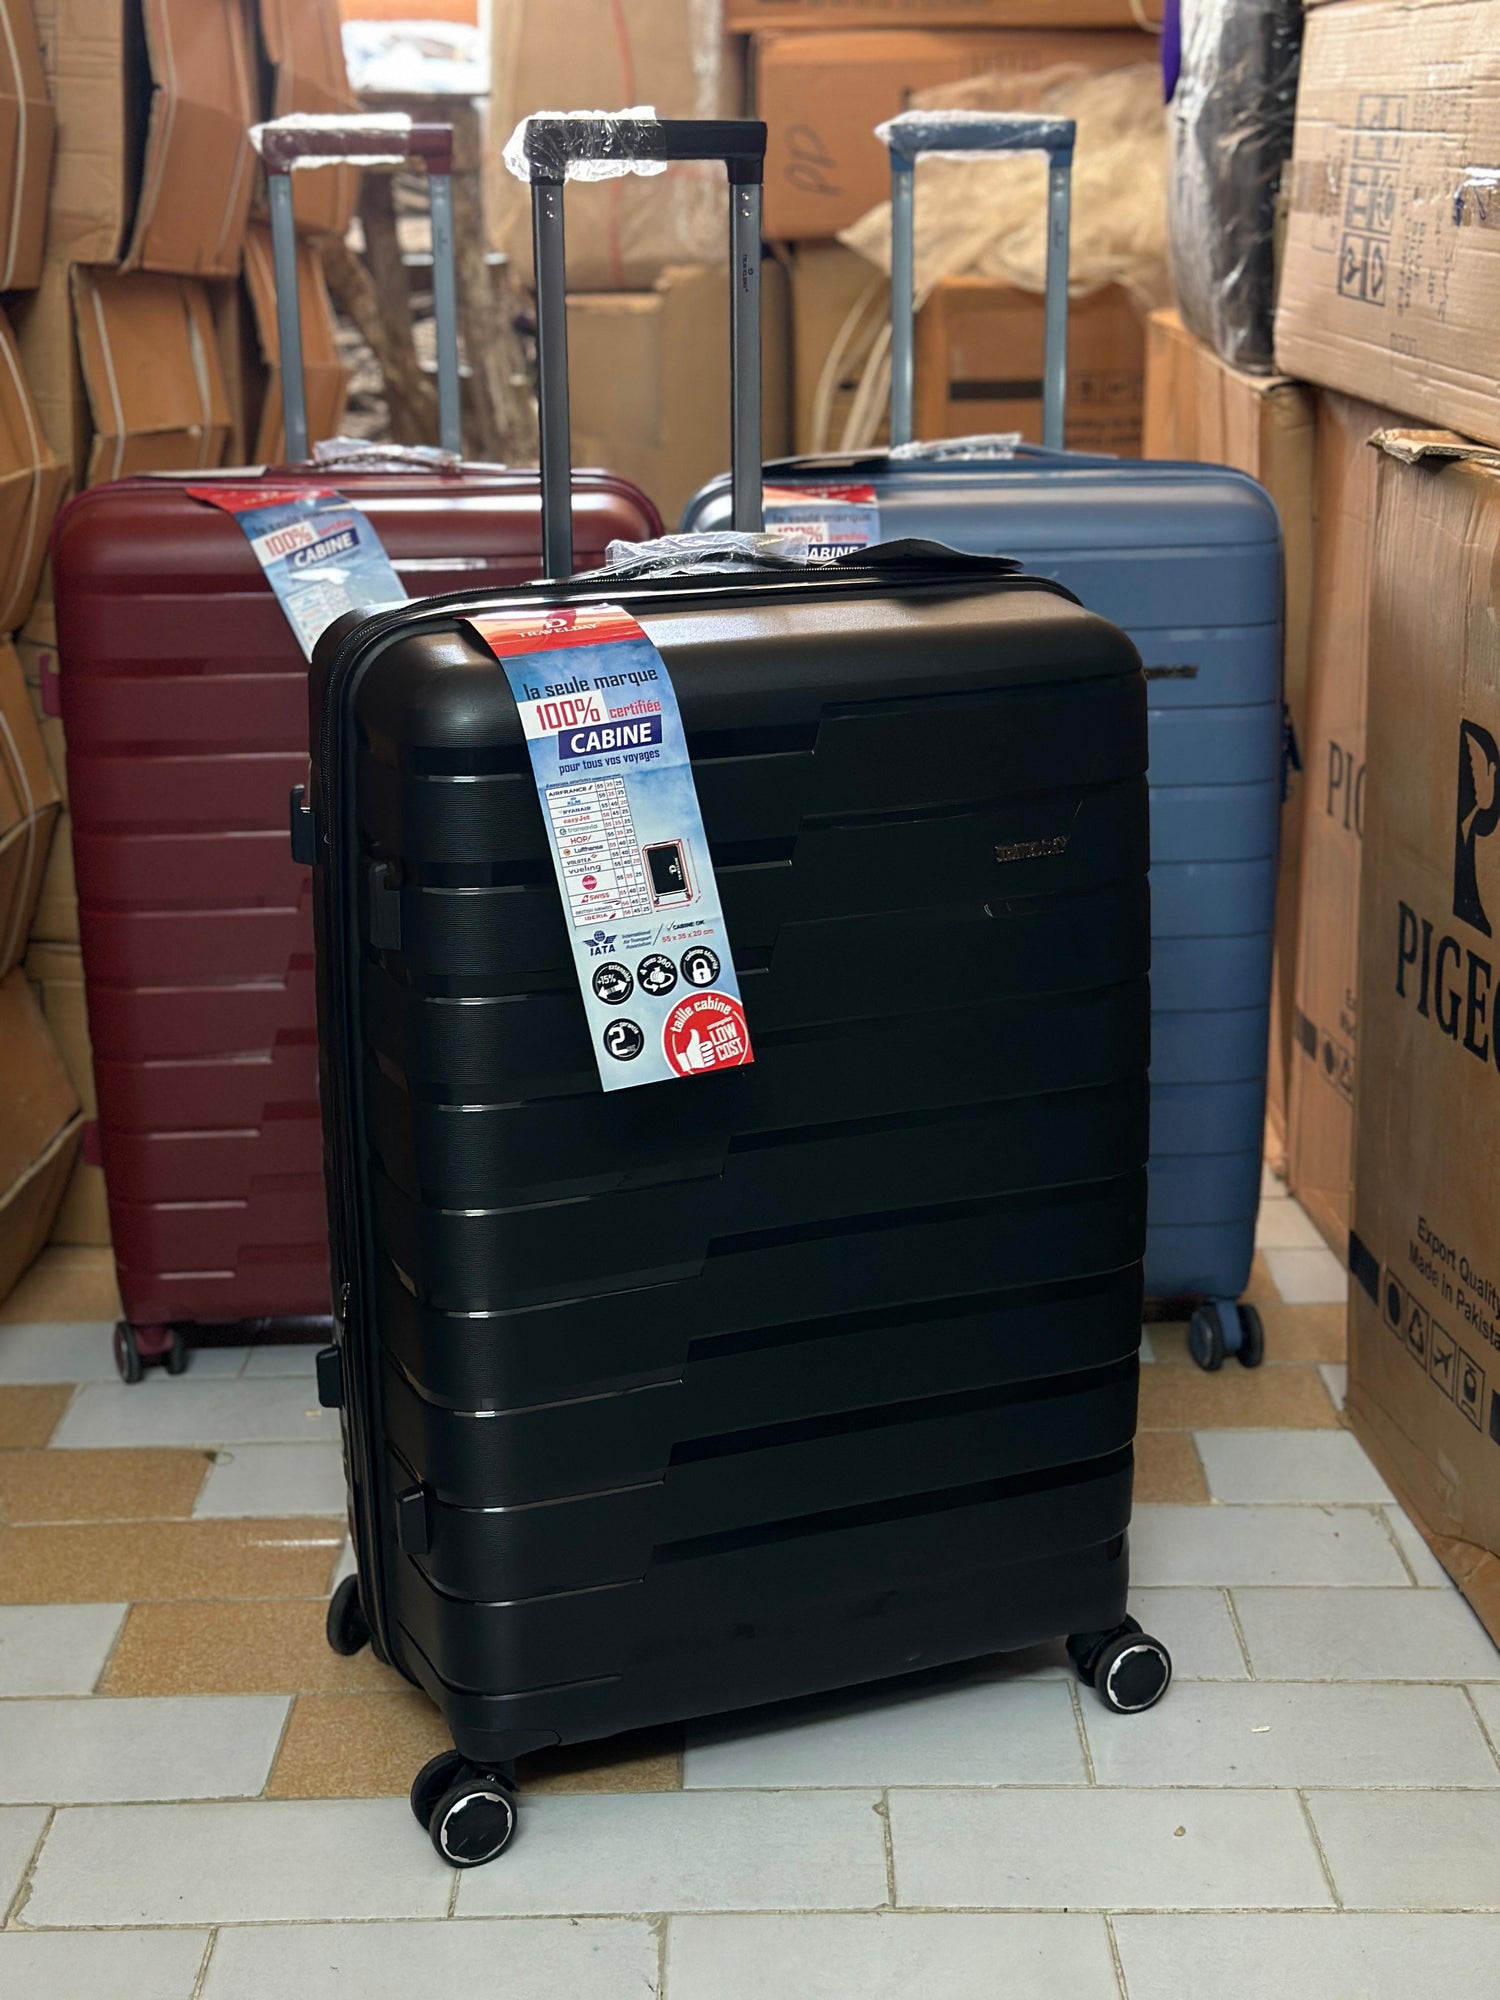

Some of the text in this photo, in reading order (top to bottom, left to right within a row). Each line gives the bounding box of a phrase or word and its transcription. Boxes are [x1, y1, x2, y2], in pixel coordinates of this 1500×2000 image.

[264, 526, 314, 558] 100%
[294, 531, 354, 568] CABINE
[517, 623, 598, 638] TRAVELDAY
[523, 669, 658, 700] la seule marque
[536, 697, 662, 731] 100% certifiée
[570, 722, 652, 754] CABINE
[559, 750, 660, 775] pour tous vos voyages
[548, 786, 588, 798] AIRFRANCE
[568, 824, 598, 833] transavia
[574, 845, 604, 853] Lufthansa
[568, 864, 602, 874] vueling
[589, 892, 610, 901] SWISS
[590, 944, 616, 957] IATA
[670, 995, 732, 1033] taille cabine
[608, 1026, 628, 1055] 2
[709, 1021, 738, 1046] LOW
[715, 1036, 744, 1062] COST
[1418, 1215, 1456, 1272] Export
[1409, 1240, 1440, 1288] Made
